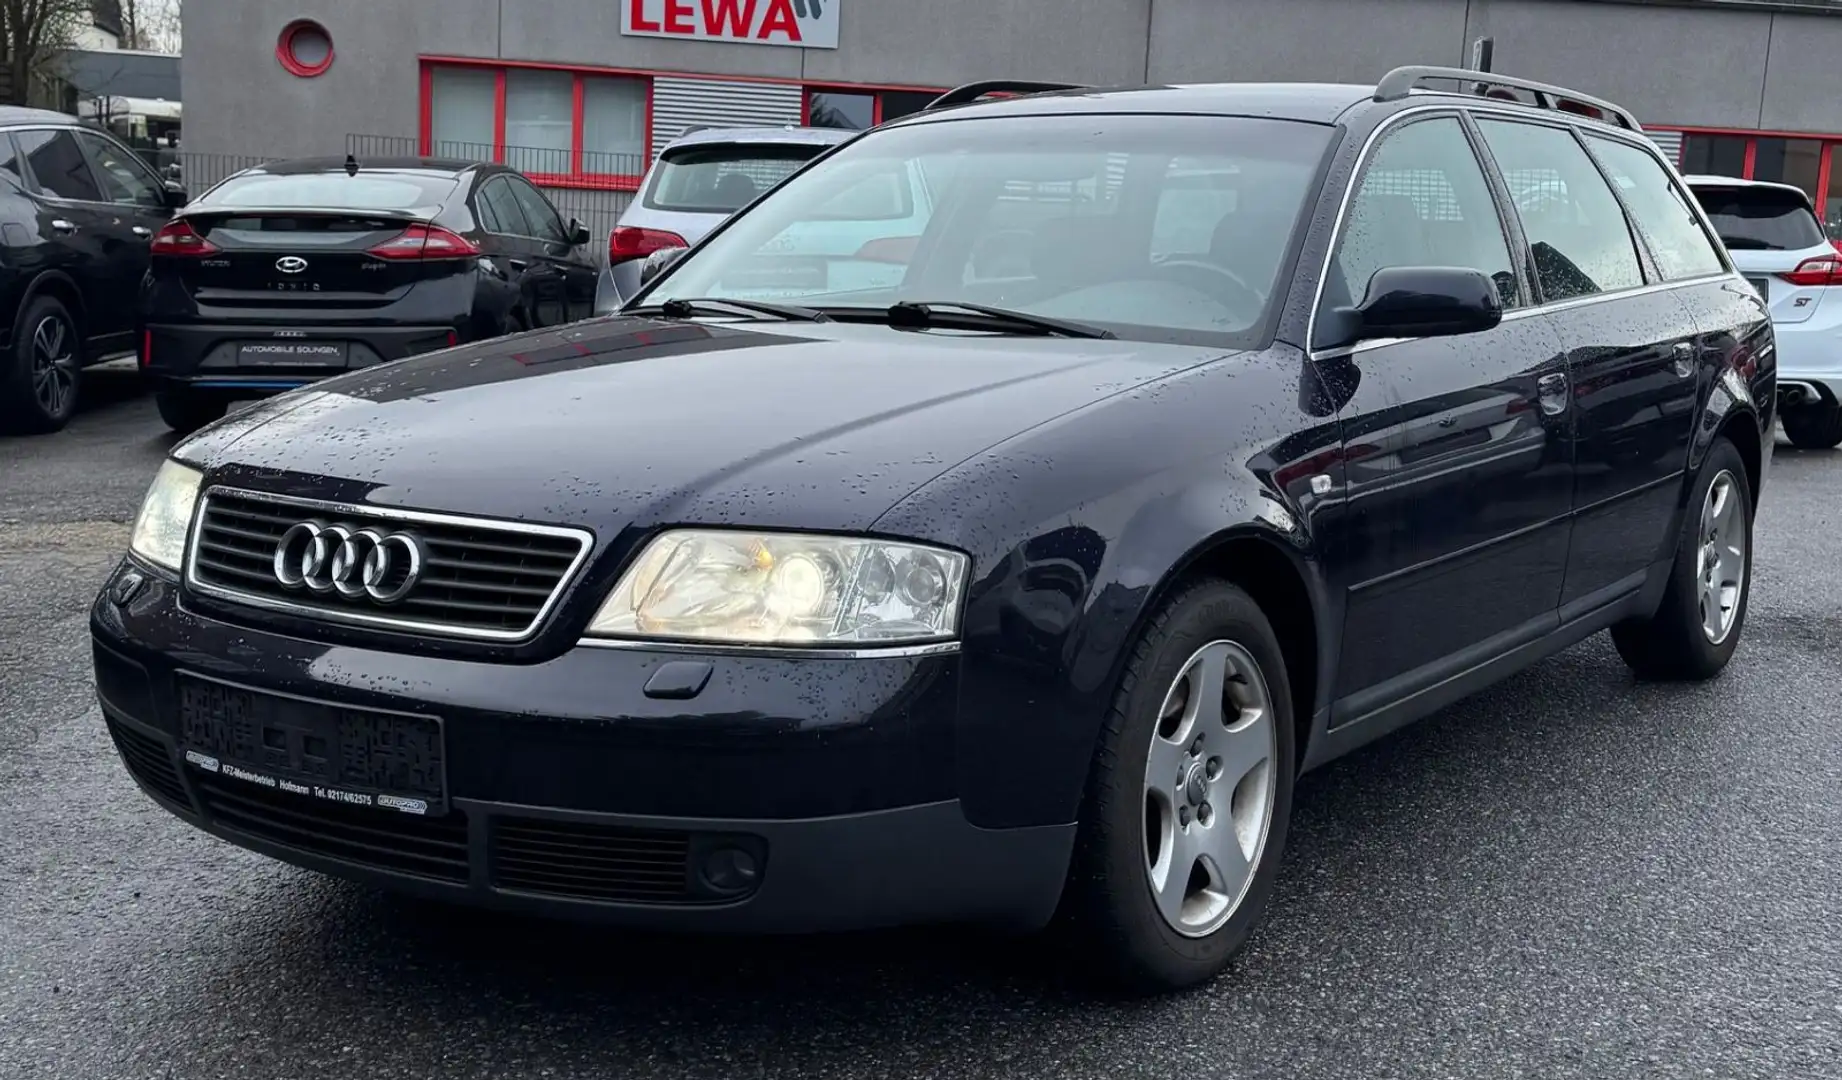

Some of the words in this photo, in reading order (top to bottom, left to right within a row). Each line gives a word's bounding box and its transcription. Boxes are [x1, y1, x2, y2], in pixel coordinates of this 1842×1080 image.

[630, 0, 802, 41] LEWA
[1793, 297, 1812, 307] ST
[241, 345, 294, 353] AUTOMOBILE
[222, 764, 276, 787] KFZ-Meisterbetrieb
[279, 779, 310, 795] Hofmann
